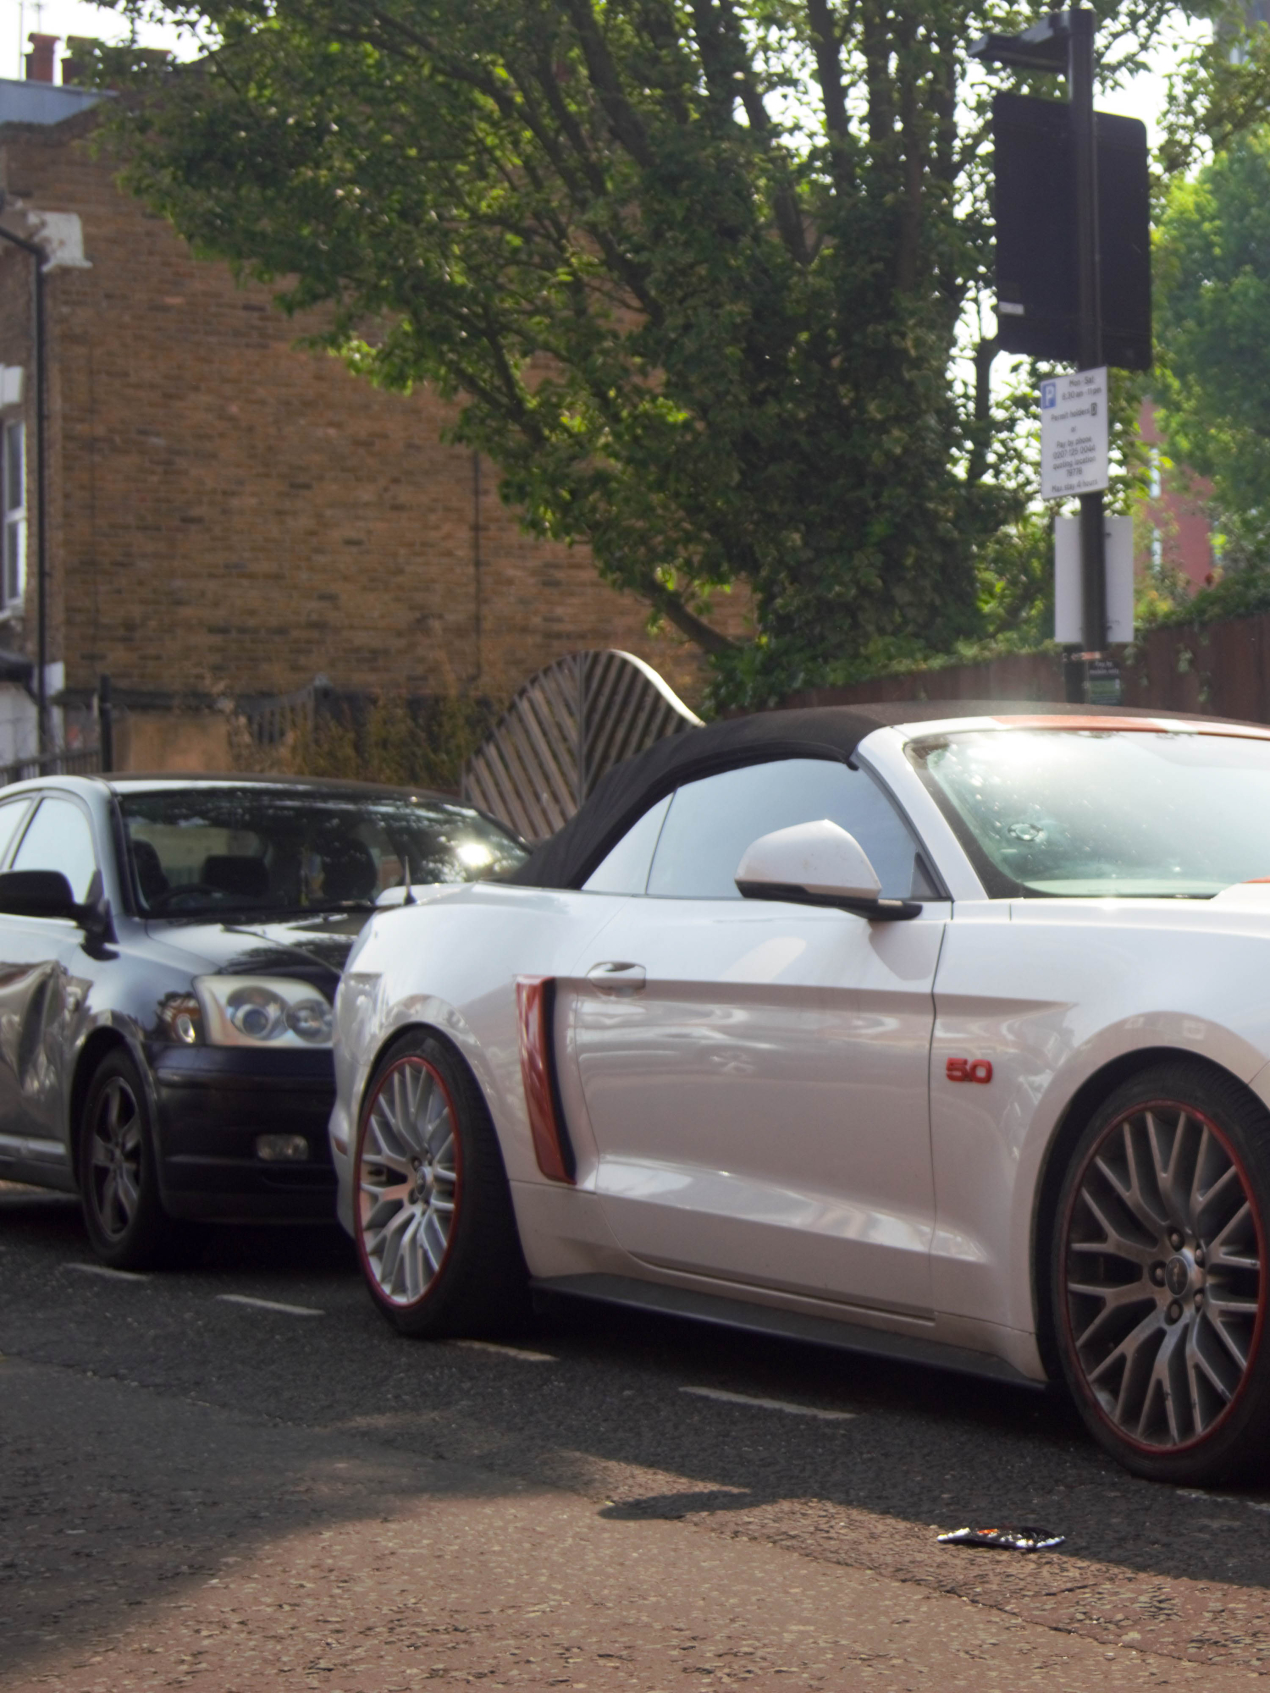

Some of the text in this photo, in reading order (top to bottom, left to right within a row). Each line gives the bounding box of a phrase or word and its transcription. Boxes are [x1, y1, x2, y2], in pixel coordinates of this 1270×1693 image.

[1051, 411, 1069, 421] Permit
[1069, 407, 1090, 418] holders
[1056, 436, 1092, 448] Pay by phone
[1052, 455, 1096, 471] quoting location
[1064, 483, 1075, 491] stay
[1082, 479, 1098, 487] hours
